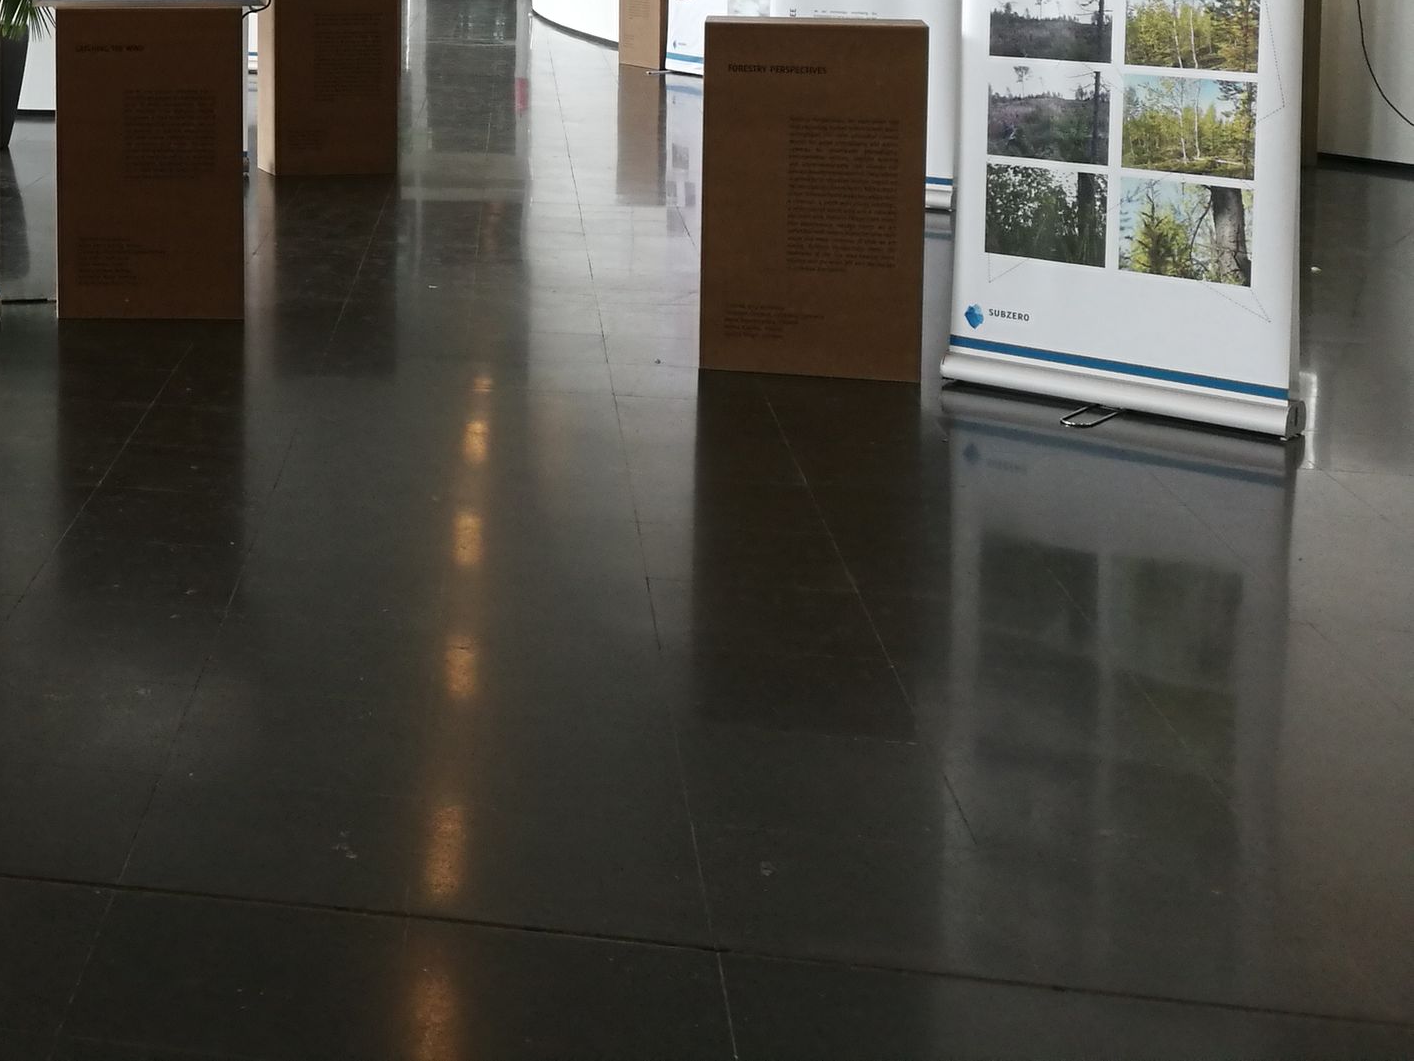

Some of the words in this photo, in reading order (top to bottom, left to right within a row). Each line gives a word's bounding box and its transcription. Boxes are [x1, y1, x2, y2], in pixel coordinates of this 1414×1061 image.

[728, 64, 766, 73] FORESTRY
[770, 65, 827, 75] PERSPECTIVES
[988, 308, 1030, 321] SUBZERO
